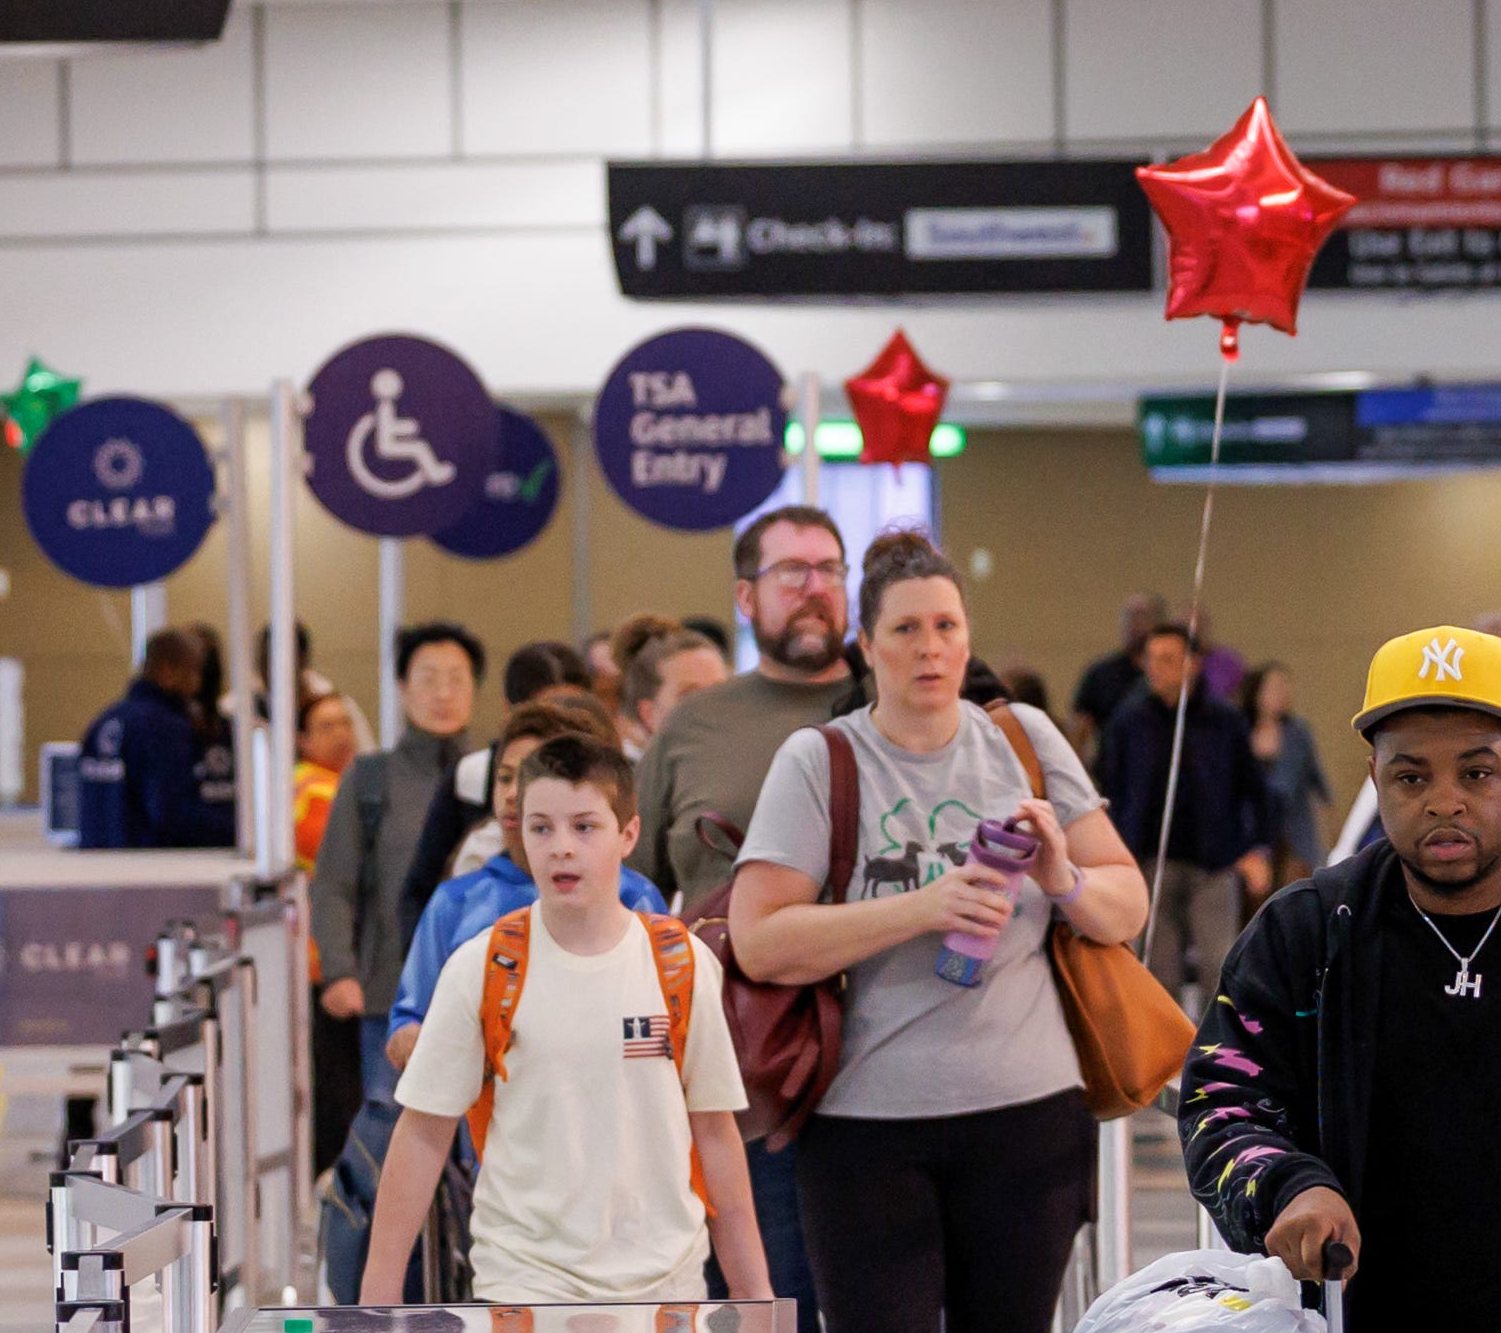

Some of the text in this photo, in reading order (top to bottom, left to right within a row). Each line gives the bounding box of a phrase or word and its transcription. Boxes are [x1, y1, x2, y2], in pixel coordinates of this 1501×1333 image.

[628, 370, 699, 409] TSA
[629, 407, 773, 447] General
[630, 449, 729, 495] Entry
[65, 495, 177, 531] CLEAR
[1417, 637, 1465, 683] NY
[19, 940, 131, 973] CLEAR
